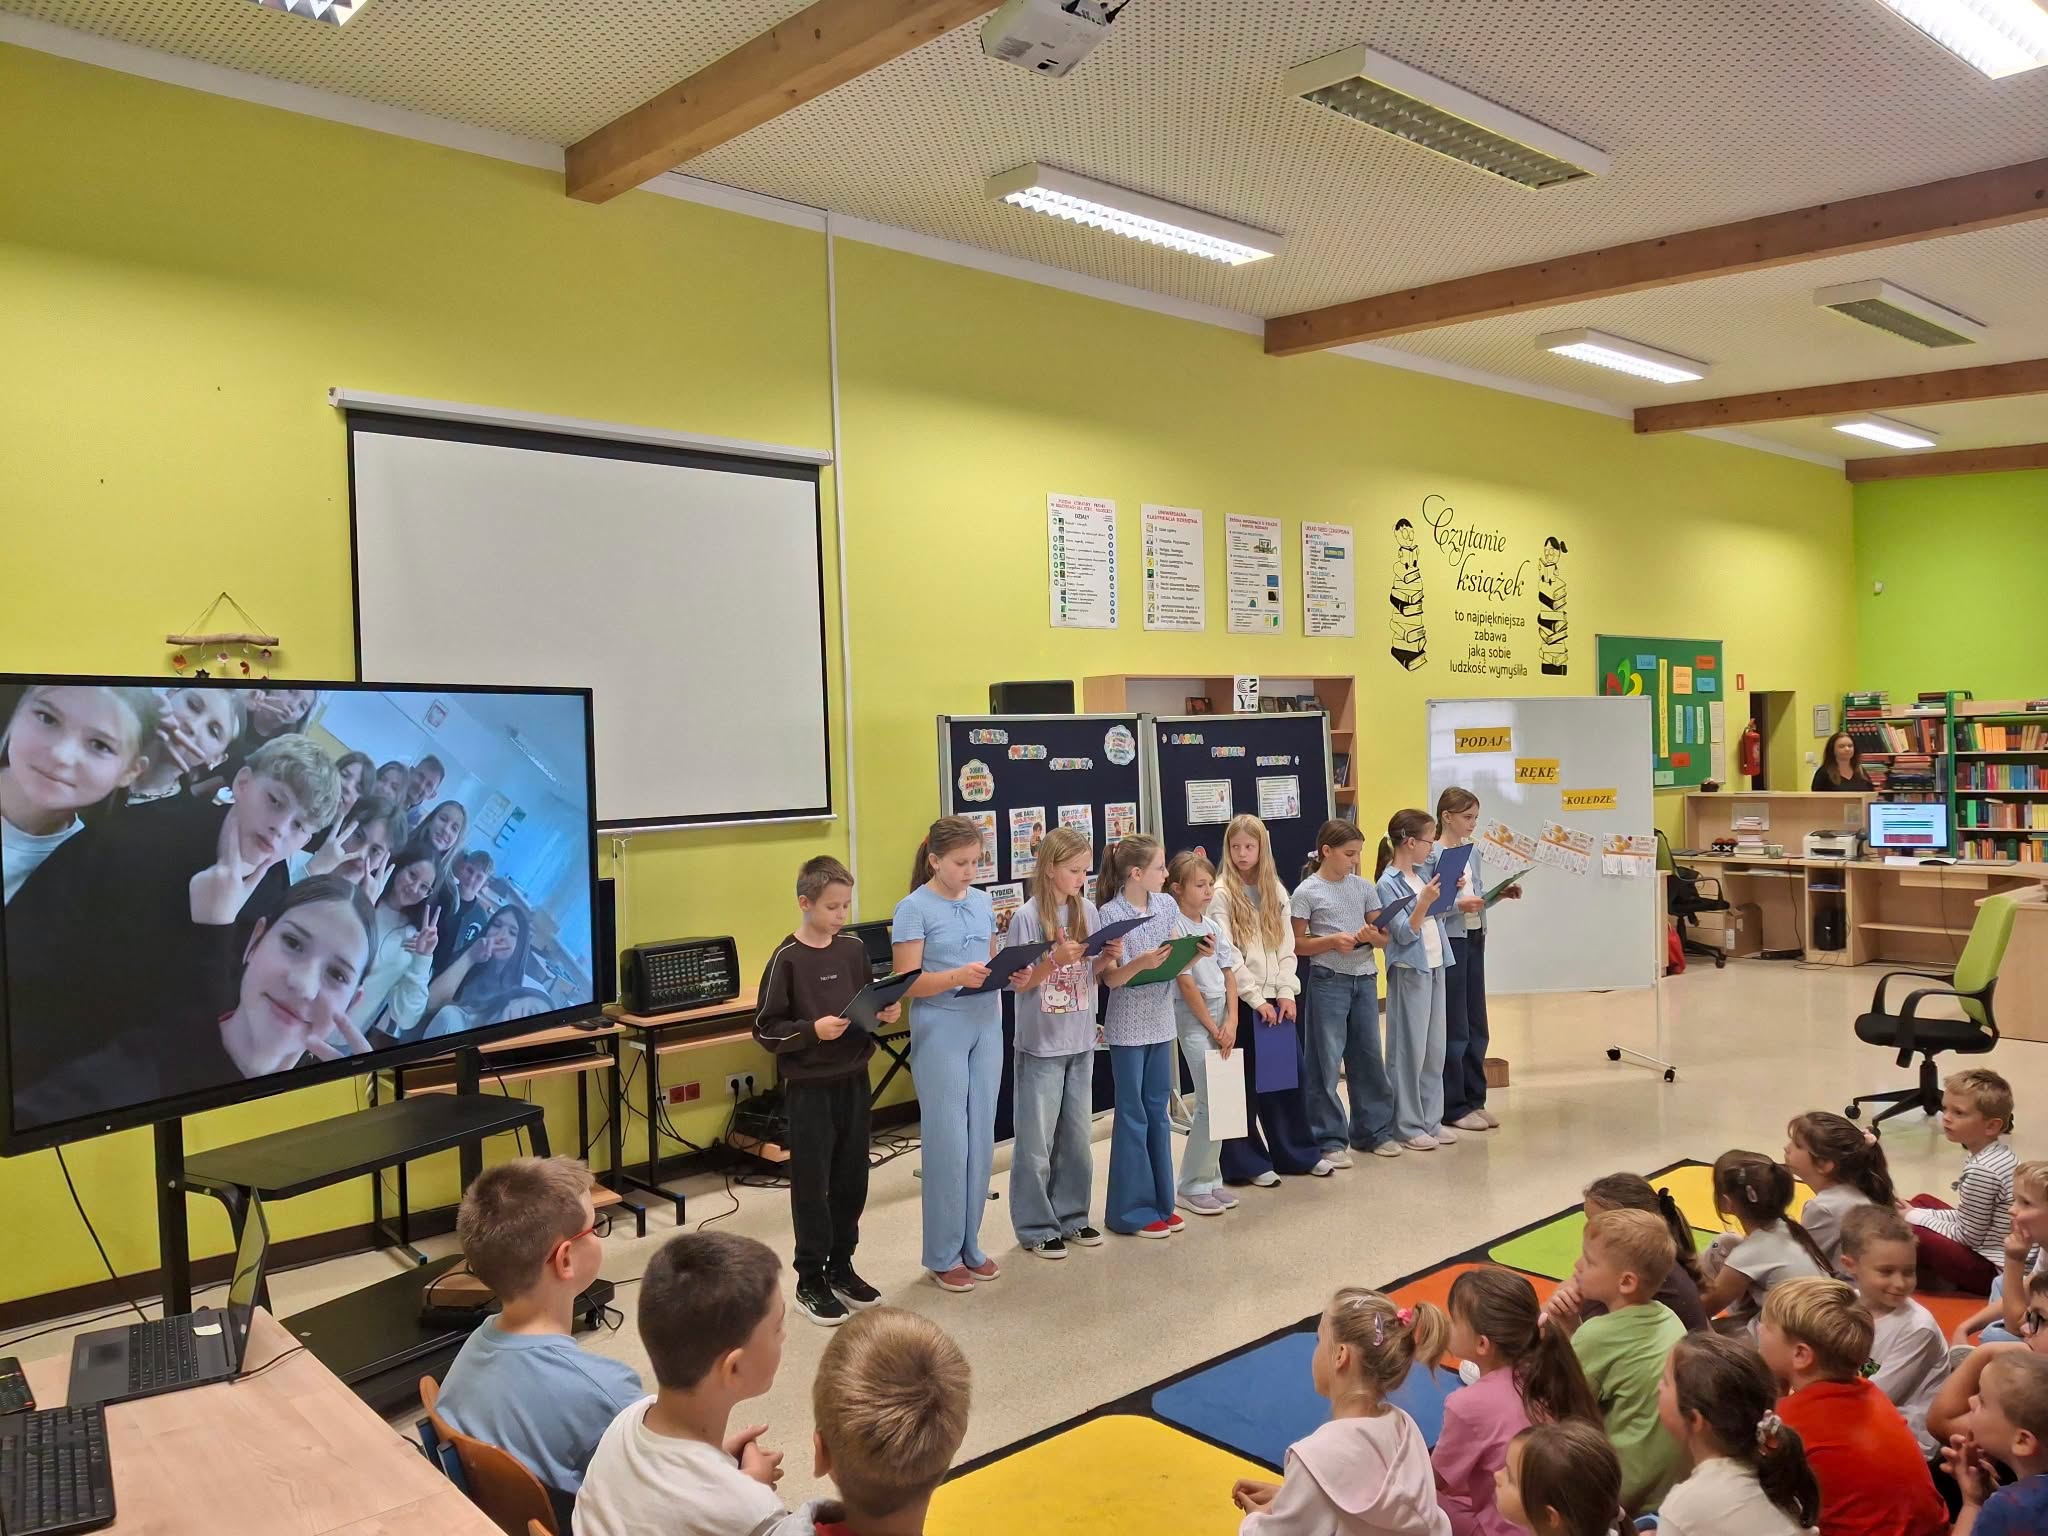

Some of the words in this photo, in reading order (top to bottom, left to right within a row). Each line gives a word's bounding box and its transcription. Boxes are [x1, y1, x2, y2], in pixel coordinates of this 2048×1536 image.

[1422, 494, 1507, 566] Czytanie
[1456, 553, 1531, 601] książek
[1454, 609, 1465, 621] to
[1466, 610, 1526, 629] najpiękniejsza
[1474, 628, 1507, 643] zabawa
[1468, 643, 1486, 661] jaką
[1488, 645, 1512, 659] sobie
[1449, 659, 1487, 674] ludzkość
[1488, 663, 1528, 680] wymyśliła
[1460, 735, 1504, 748] PODAJ
[1520, 766, 1556, 781] RĘKĘ
[1566, 795, 1614, 805] KOLEDZE
